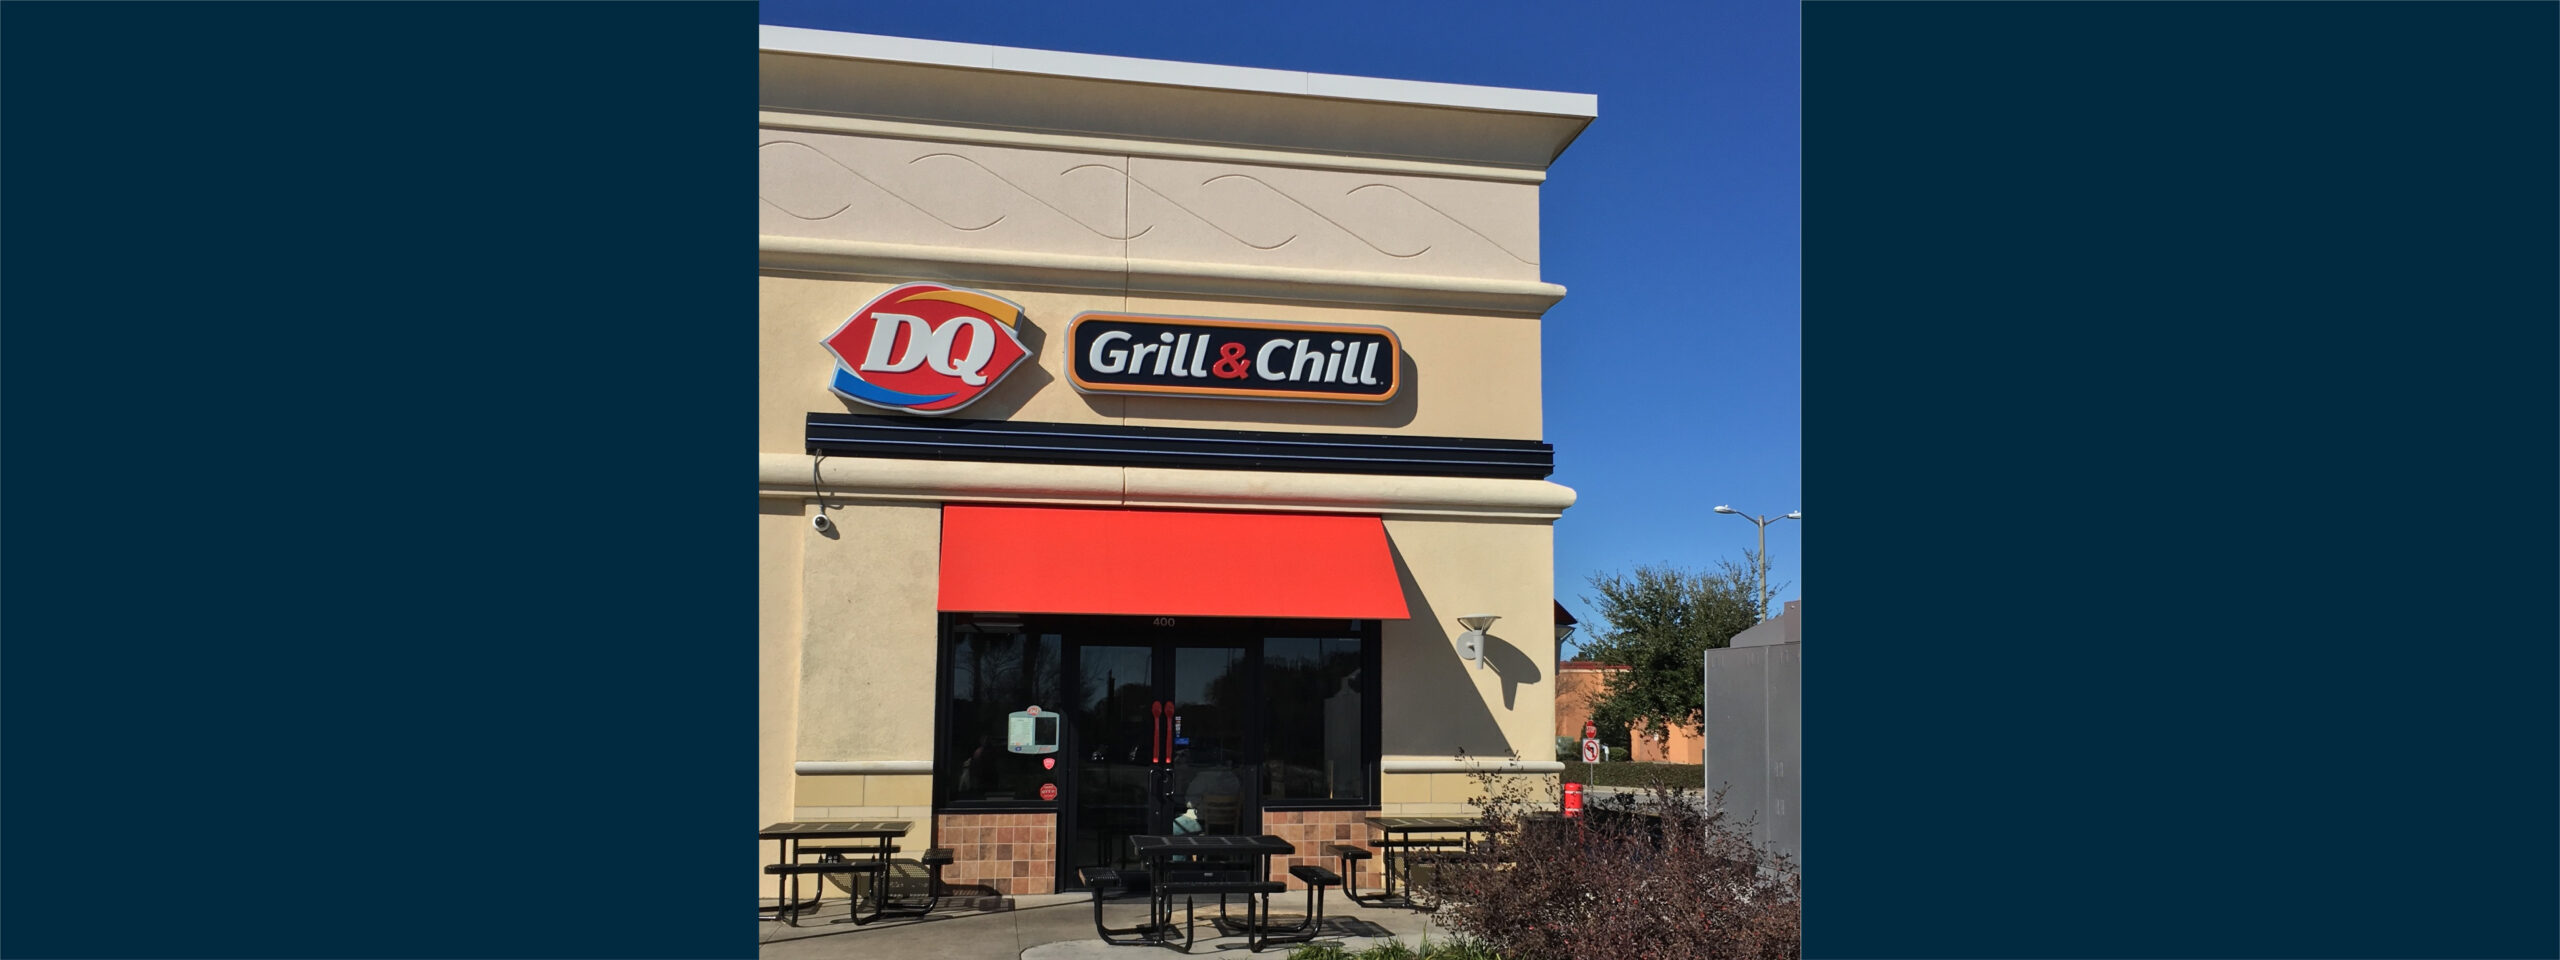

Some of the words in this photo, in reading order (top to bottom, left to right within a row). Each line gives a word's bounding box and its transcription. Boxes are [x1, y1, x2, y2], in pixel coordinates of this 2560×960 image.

[860, 312, 996, 387] DQ
[1088, 330, 1211, 378] Grill
[1255, 338, 1380, 386] Chill
[1152, 617, 1176, 627] 400
